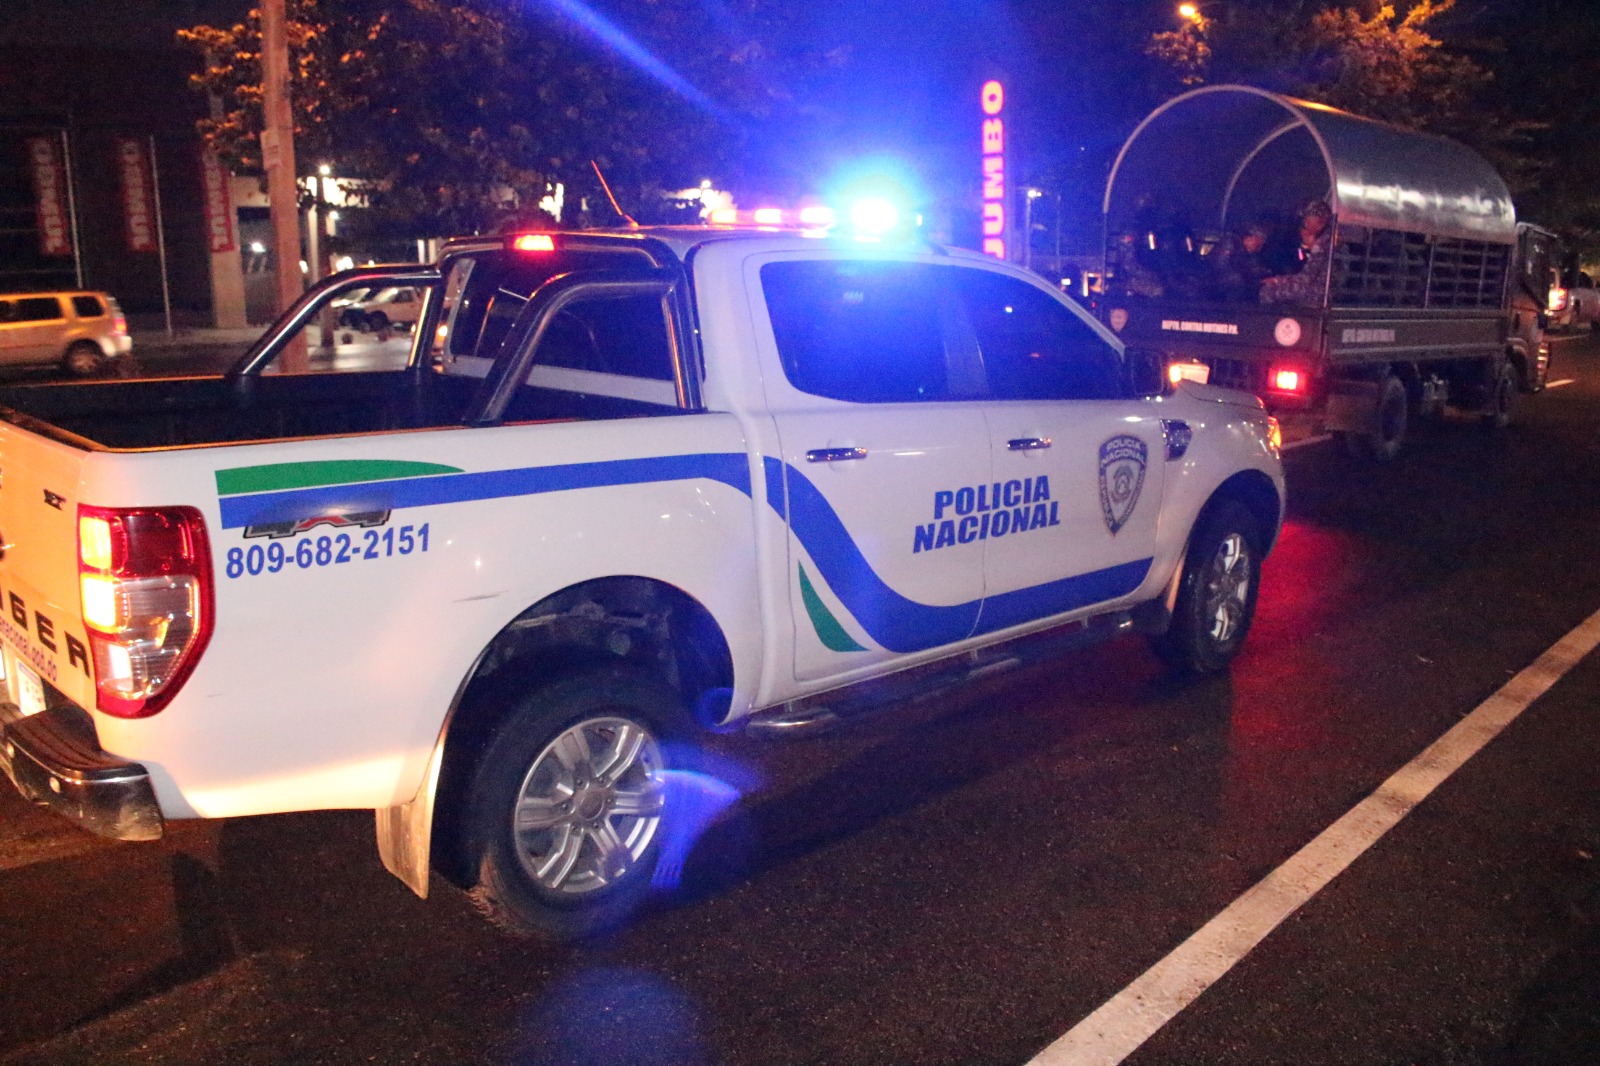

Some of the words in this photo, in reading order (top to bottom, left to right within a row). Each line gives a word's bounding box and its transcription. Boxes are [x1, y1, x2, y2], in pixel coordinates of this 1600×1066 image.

[981, 79, 1006, 259] JUMBO
[1100, 449, 1145, 468] NACIONAL
[1106, 438, 1141, 451] POLICIA
[934, 475, 1050, 519] POLICIA
[226, 523, 430, 579] 809-682-2151
[913, 501, 1060, 554] NACIONAL
[0, 587, 91, 679] GER
